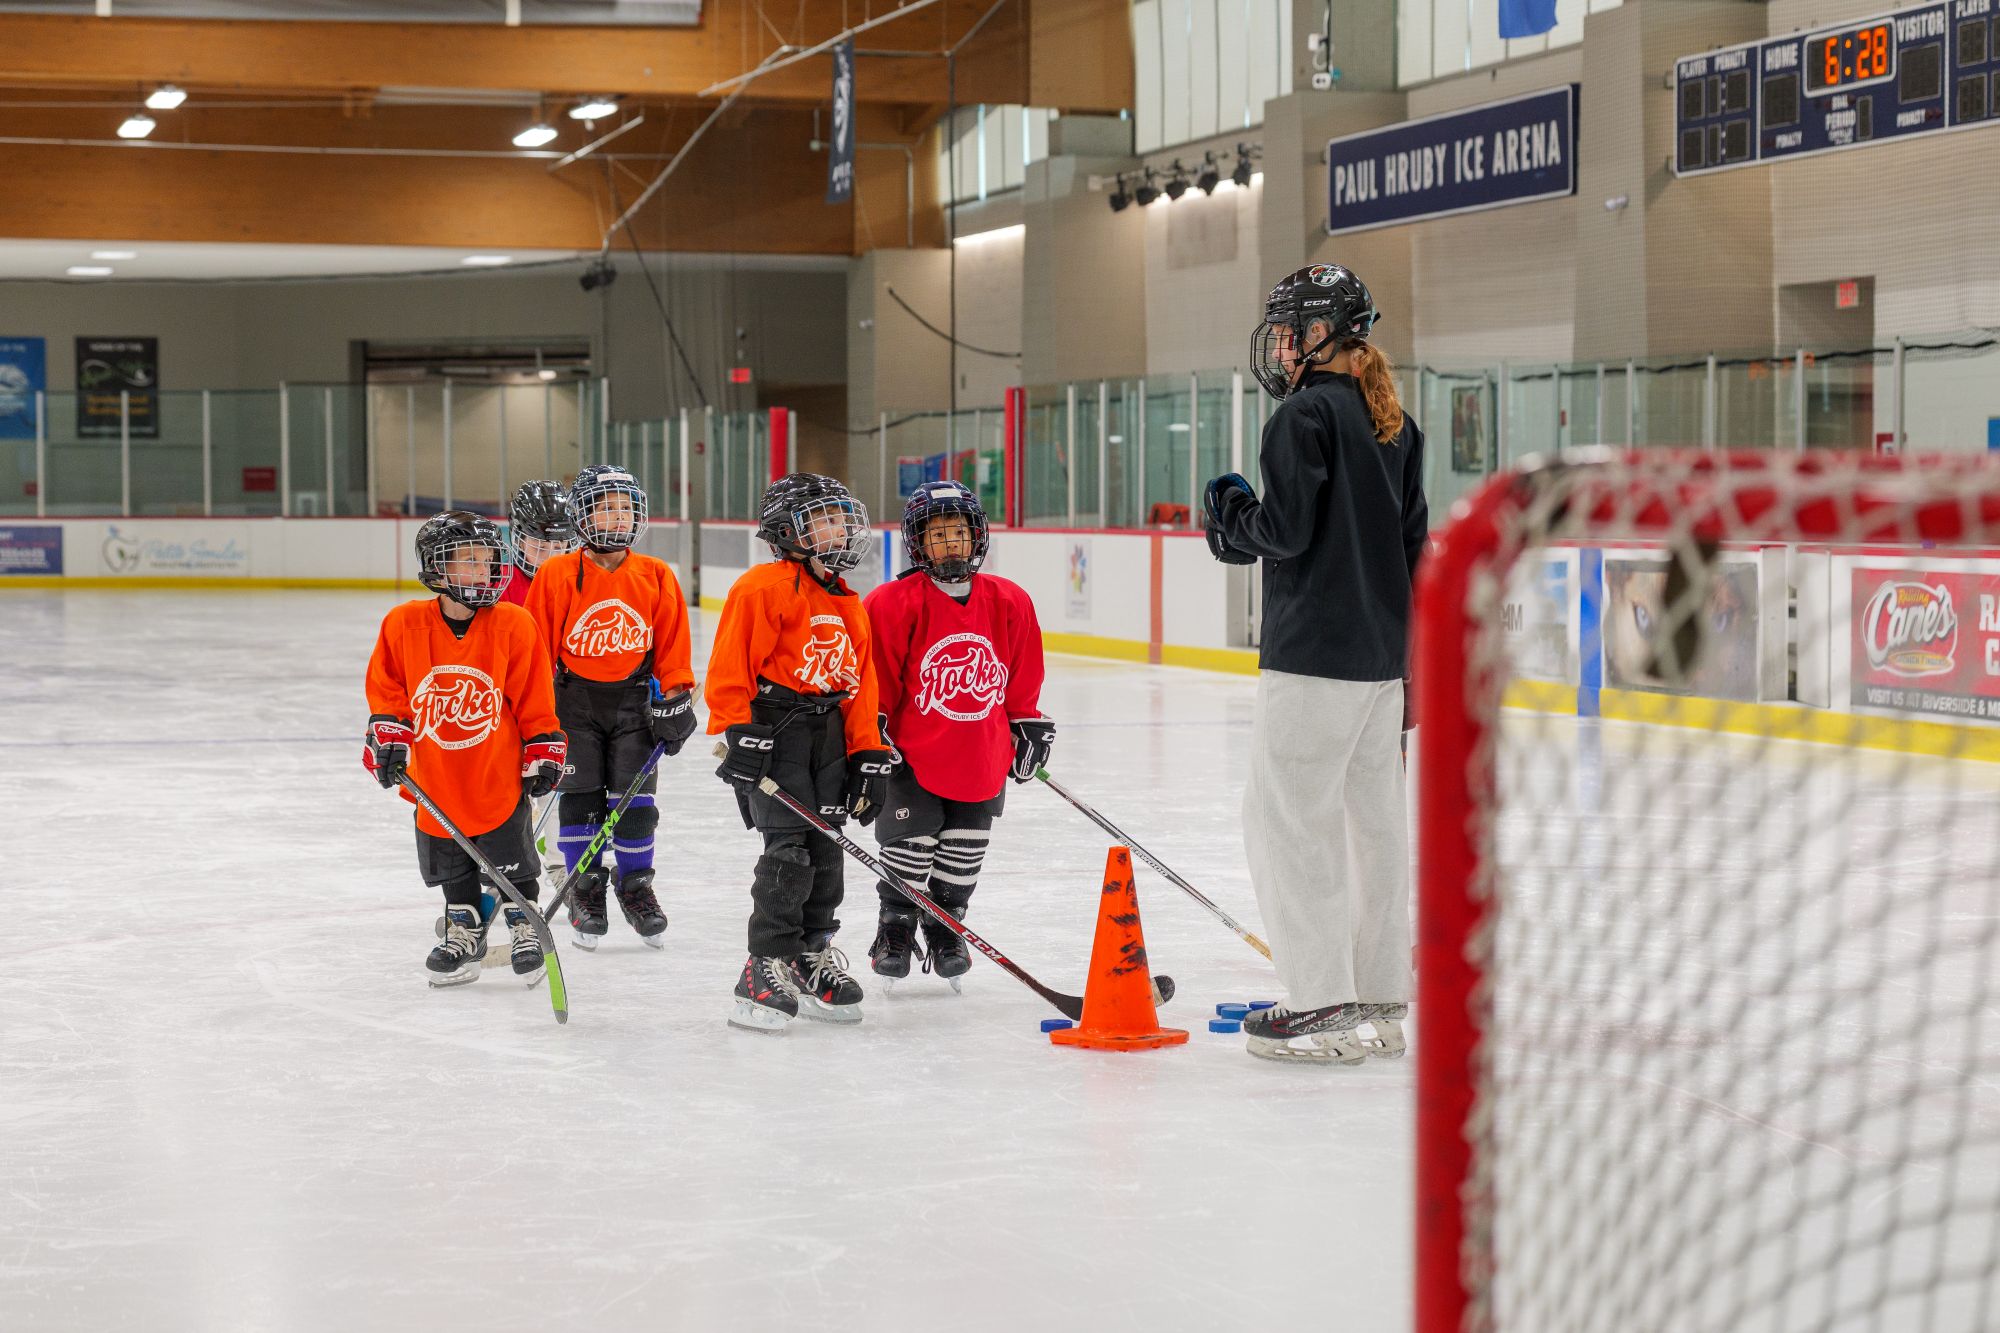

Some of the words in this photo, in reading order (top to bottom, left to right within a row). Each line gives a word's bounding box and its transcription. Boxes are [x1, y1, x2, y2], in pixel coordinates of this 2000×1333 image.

[1897, 10, 1944, 43] VISITOR
[1714, 50, 1747, 73] PENALTY
[1766, 44, 1798, 71] HOME
[1823, 26, 1888, 85] 6:28
[1335, 159, 1378, 206] PAUL
[1384, 143, 1447, 197] HRUBY
[1455, 136, 1484, 184] ICE
[1492, 120, 1561, 176] ARENA
[1303, 299, 1331, 307] CCM
[1867, 580, 1955, 667] Cane's
[914, 647, 1008, 716] Hockey
[411, 679, 502, 742] Hockey
[651, 698, 692, 718] AUER
[1867, 688, 1891, 704] VISIT
[1892, 691, 1904, 706] US
[1922, 693, 1976, 714] RIVERSIDE
[577, 810, 620, 873] CCM
[836, 836, 879, 868] ULTIMATE
[962, 930, 1002, 960] CCM
[1289, 1012, 1318, 1028] BAUER
